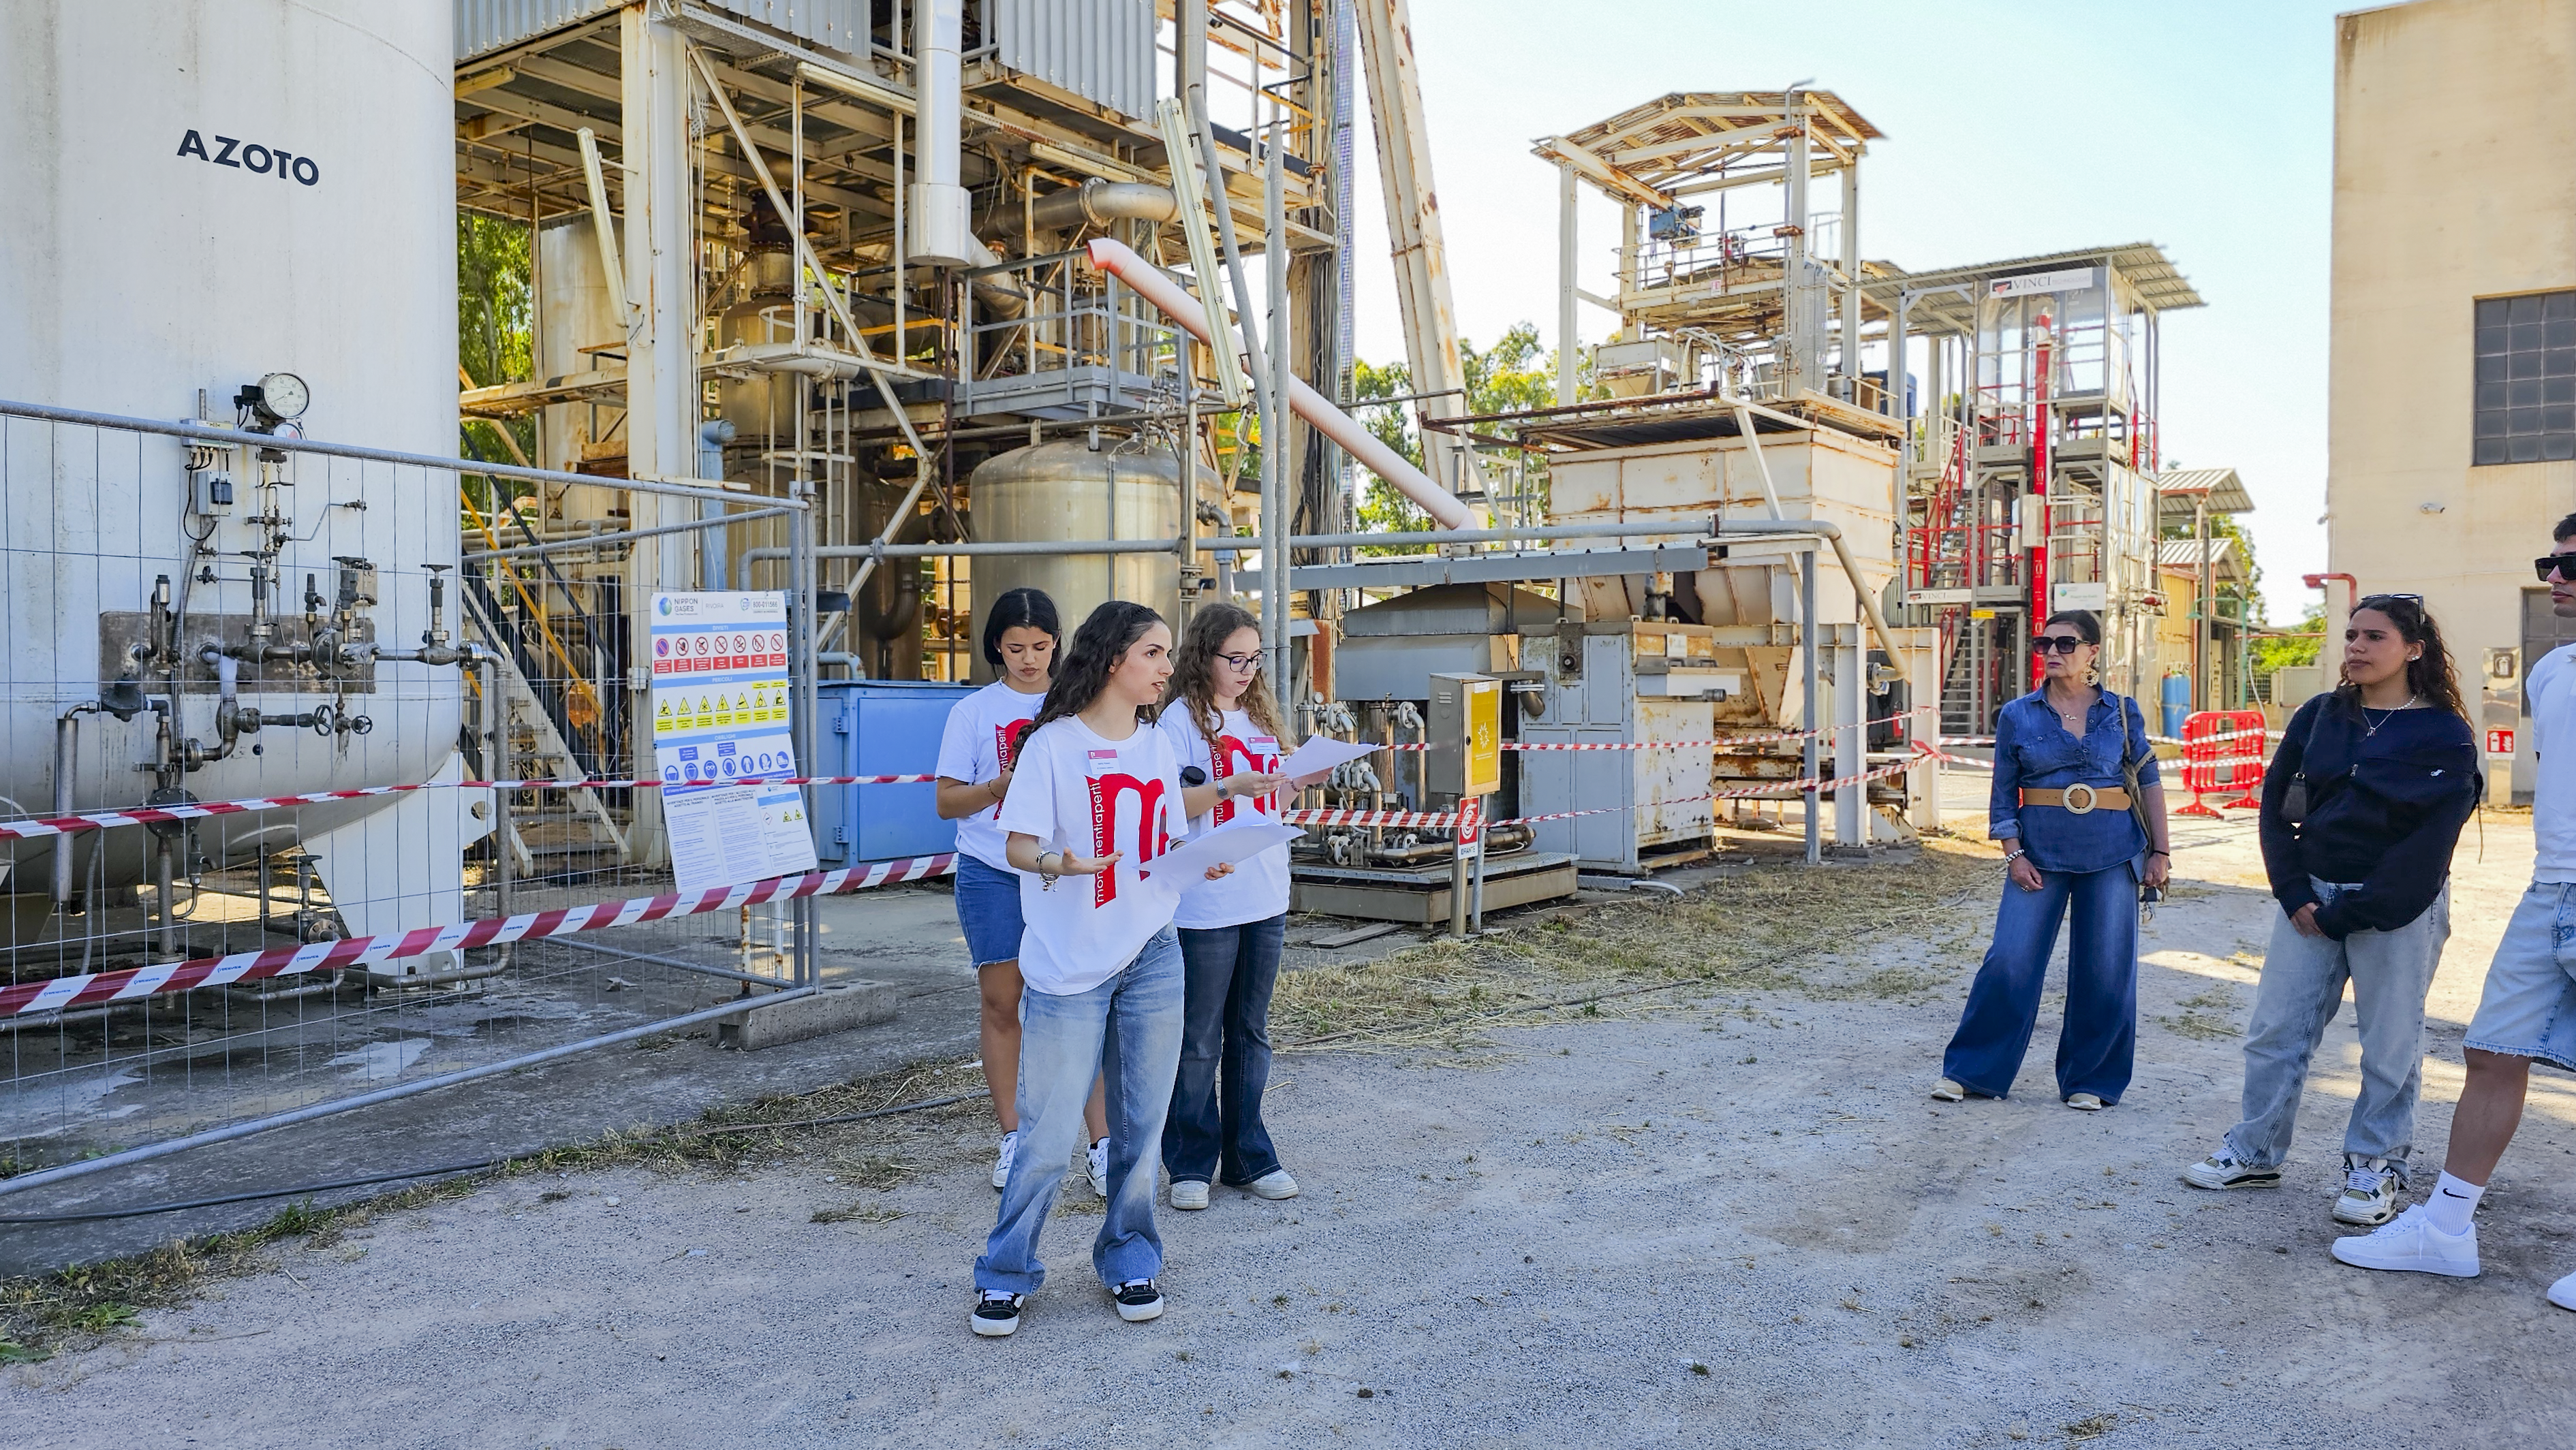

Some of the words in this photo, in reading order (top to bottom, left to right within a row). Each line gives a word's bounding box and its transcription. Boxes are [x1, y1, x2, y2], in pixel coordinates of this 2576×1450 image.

[176, 129, 319, 186] AZOTO
[2013, 276, 2051, 290] VINCI
[1089, 782, 1105, 902] monmentiaperti
